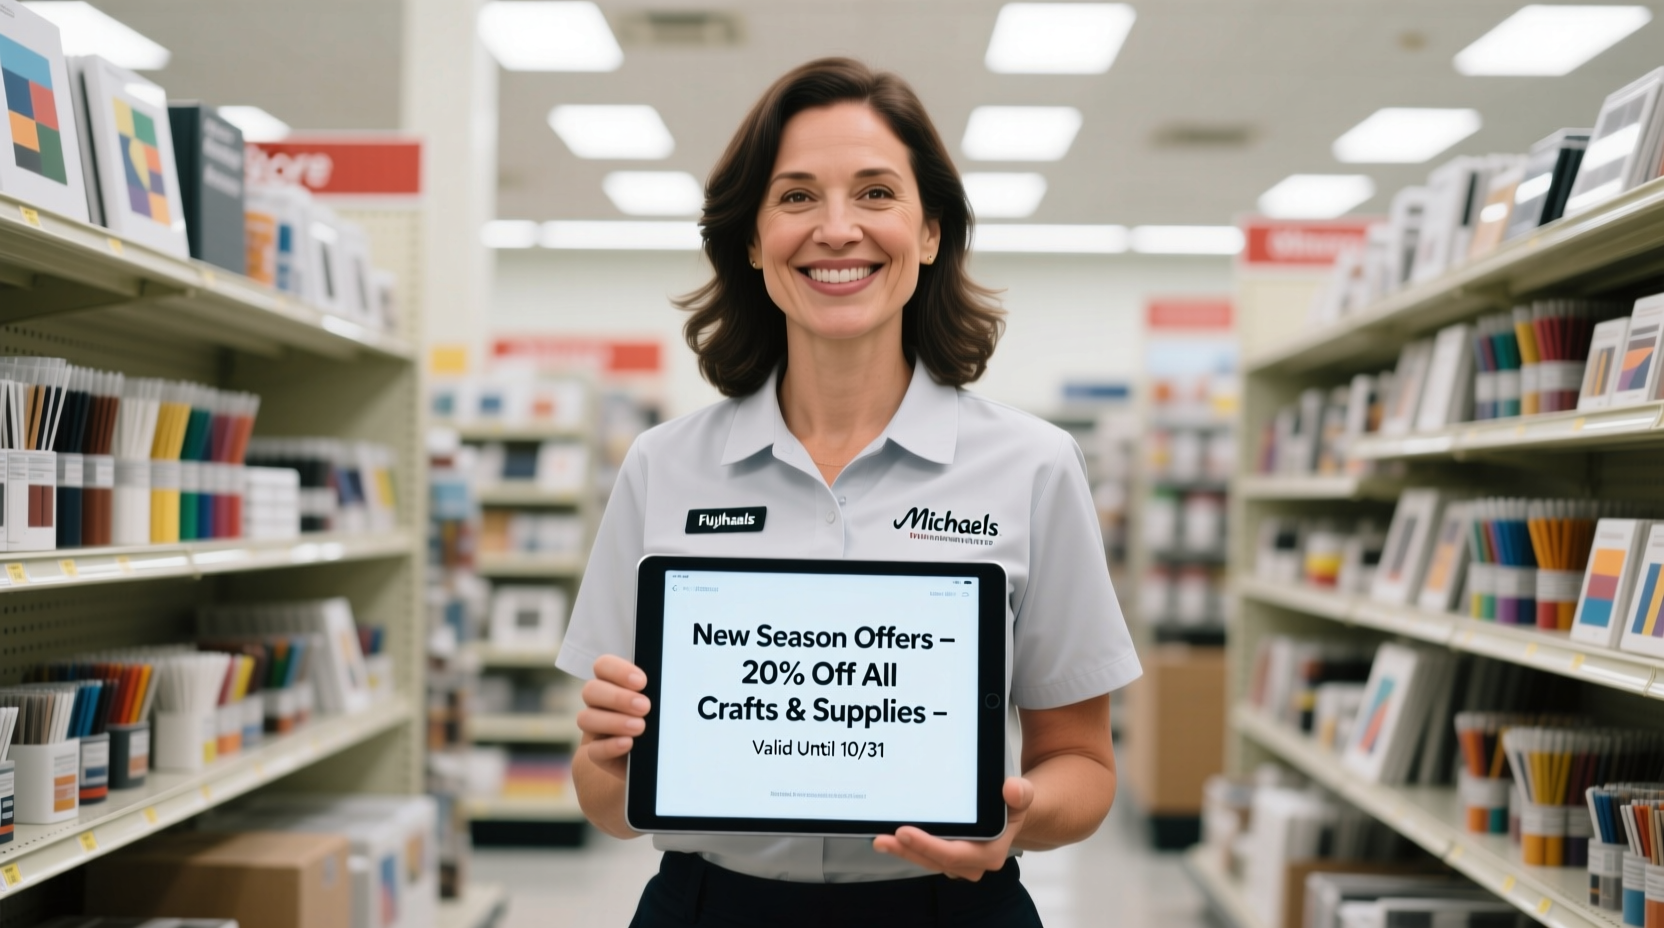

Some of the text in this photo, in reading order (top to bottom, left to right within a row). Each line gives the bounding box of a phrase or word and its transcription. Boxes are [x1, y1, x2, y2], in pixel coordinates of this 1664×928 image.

[893, 507, 999, 536] Michaels
[693, 623, 750, 646] New
[757, 624, 846, 648] Season
[855, 626, 933, 649] Offers
[742, 660, 897, 687] 20% Off All
[698, 696, 778, 720] Crafts
[785, 697, 806, 722] &
[813, 698, 925, 728] Supplies
[753, 740, 885, 760] Valid Until 10/31
